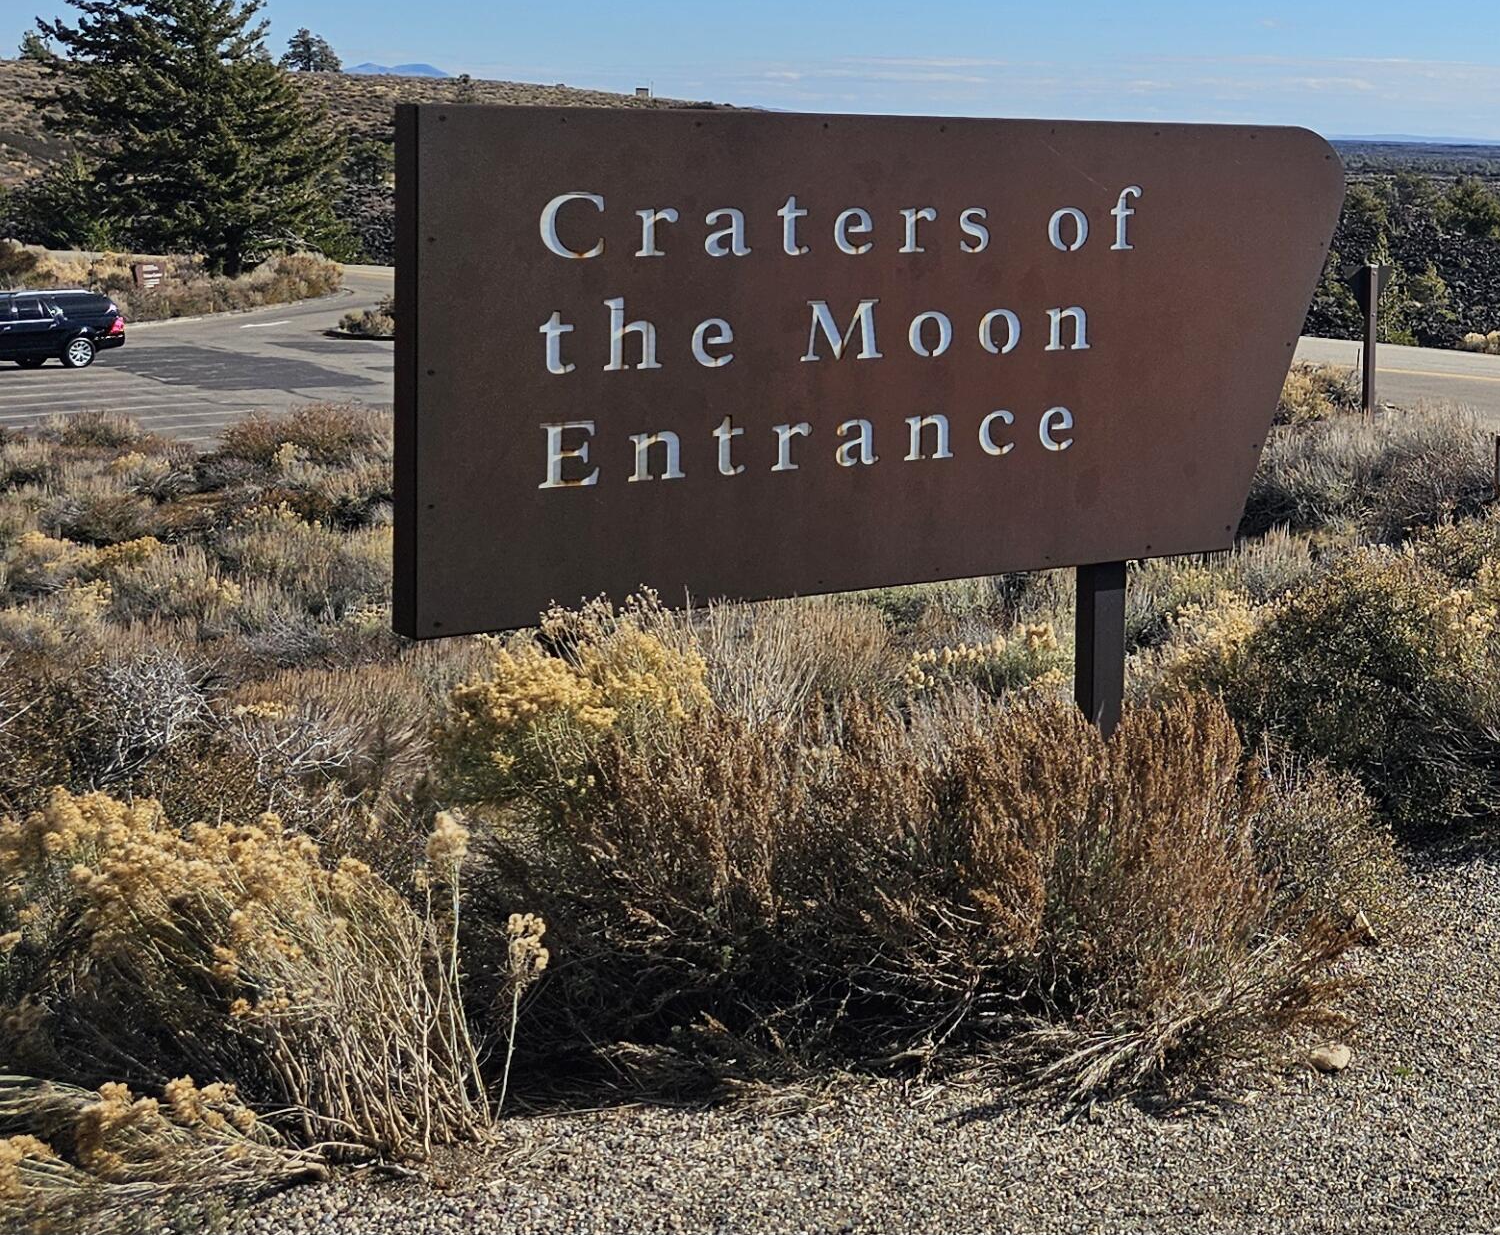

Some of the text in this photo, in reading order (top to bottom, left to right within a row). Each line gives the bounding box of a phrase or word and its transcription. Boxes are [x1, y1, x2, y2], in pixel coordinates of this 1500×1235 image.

[539, 185, 1143, 259] Craters of
[539, 296, 1091, 375] the Moon
[538, 405, 1075, 490] Entrance
